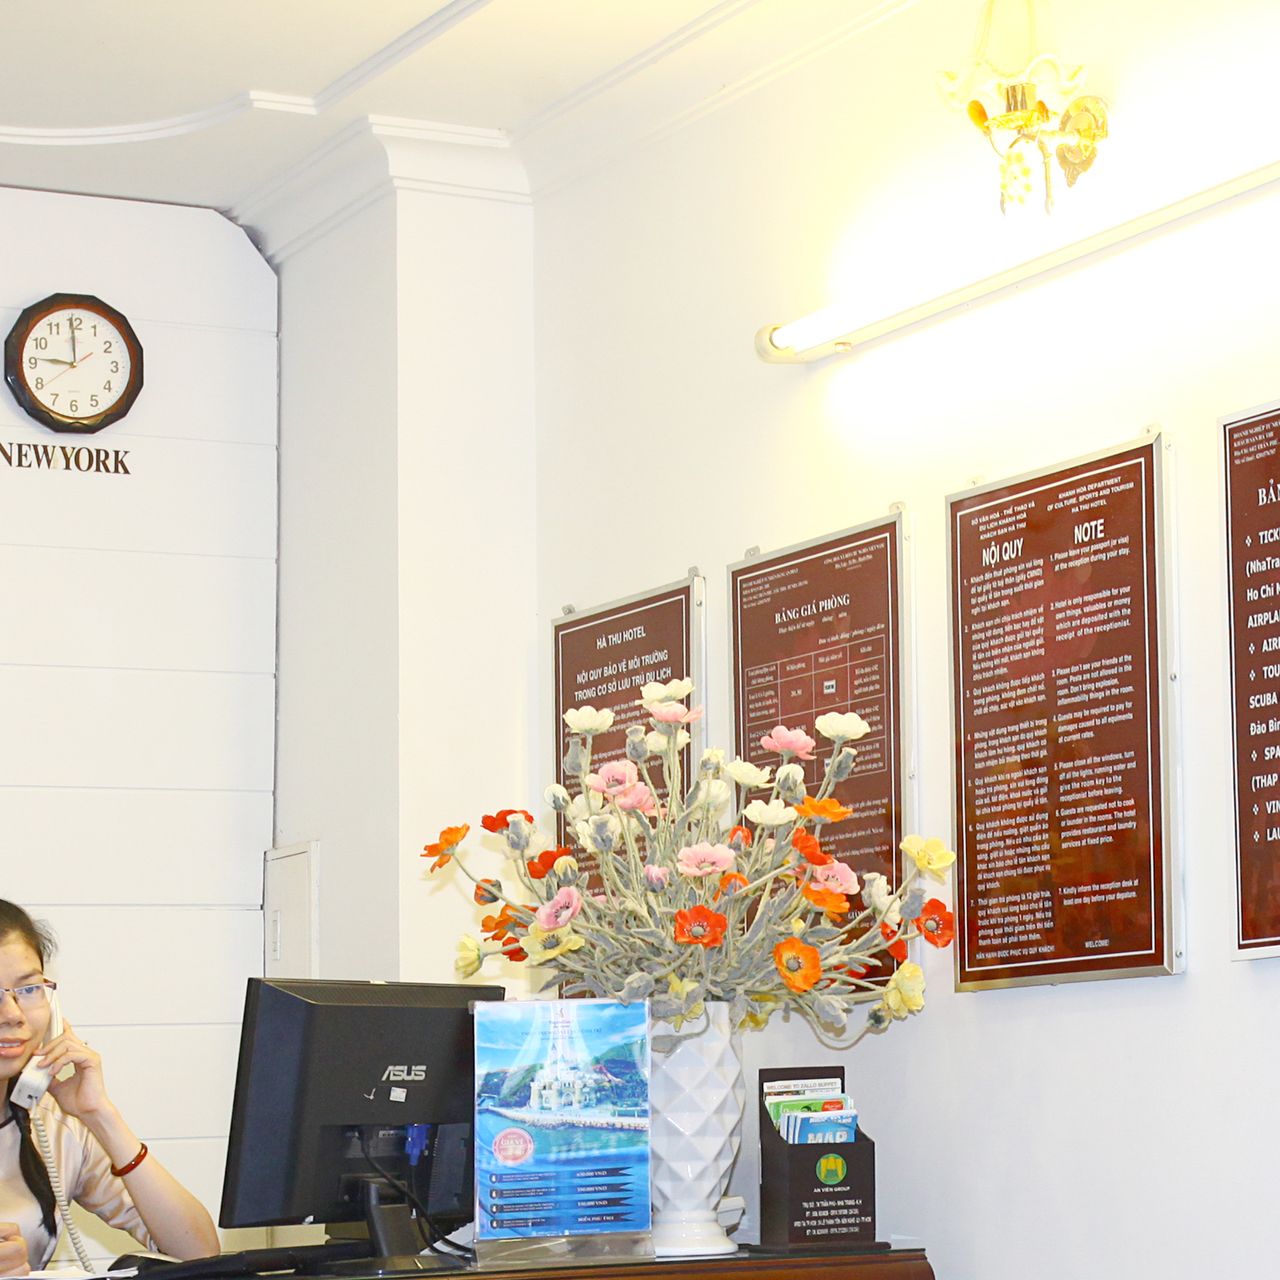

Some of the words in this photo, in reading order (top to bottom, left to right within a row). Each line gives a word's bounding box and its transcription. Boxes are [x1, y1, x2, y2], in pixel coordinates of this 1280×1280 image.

[1075, 519, 1104, 544] NOTE
[983, 541, 999, 568] NỘI
[1002, 538, 1023, 561] QUY
[1247, 586, 1258, 601] Ho
[1261, 582, 1274, 599] Chi
[775, 608, 799, 624] BẢNG
[801, 599, 817, 616] GIÁ
[819, 594, 850, 612] PHÒNG
[596, 634, 607, 649] HÀ
[608, 632, 621, 644] THU
[623, 625, 646, 642] HOTEL
[577, 670, 588, 684] NỘI
[589, 667, 603, 681] QUY
[604, 662, 617, 677] BẢO
[618, 659, 627, 674] VỆ
[628, 656, 640, 669] MÔI
[641, 650, 668, 666] TRƯỜNG
[575, 687, 596, 701] TRONG
[646, 671, 655, 682] DU
[656, 667, 671, 681] LỊCH
[1249, 692, 1278, 709] SCUBA
[1250, 719, 1266, 736] Đảo
[1264, 743, 1280, 760] SPA
[1251, 770, 1278, 792] (THAP
[381, 1065, 426, 1080] ASUS
[808, 1132, 848, 1143] MAP
